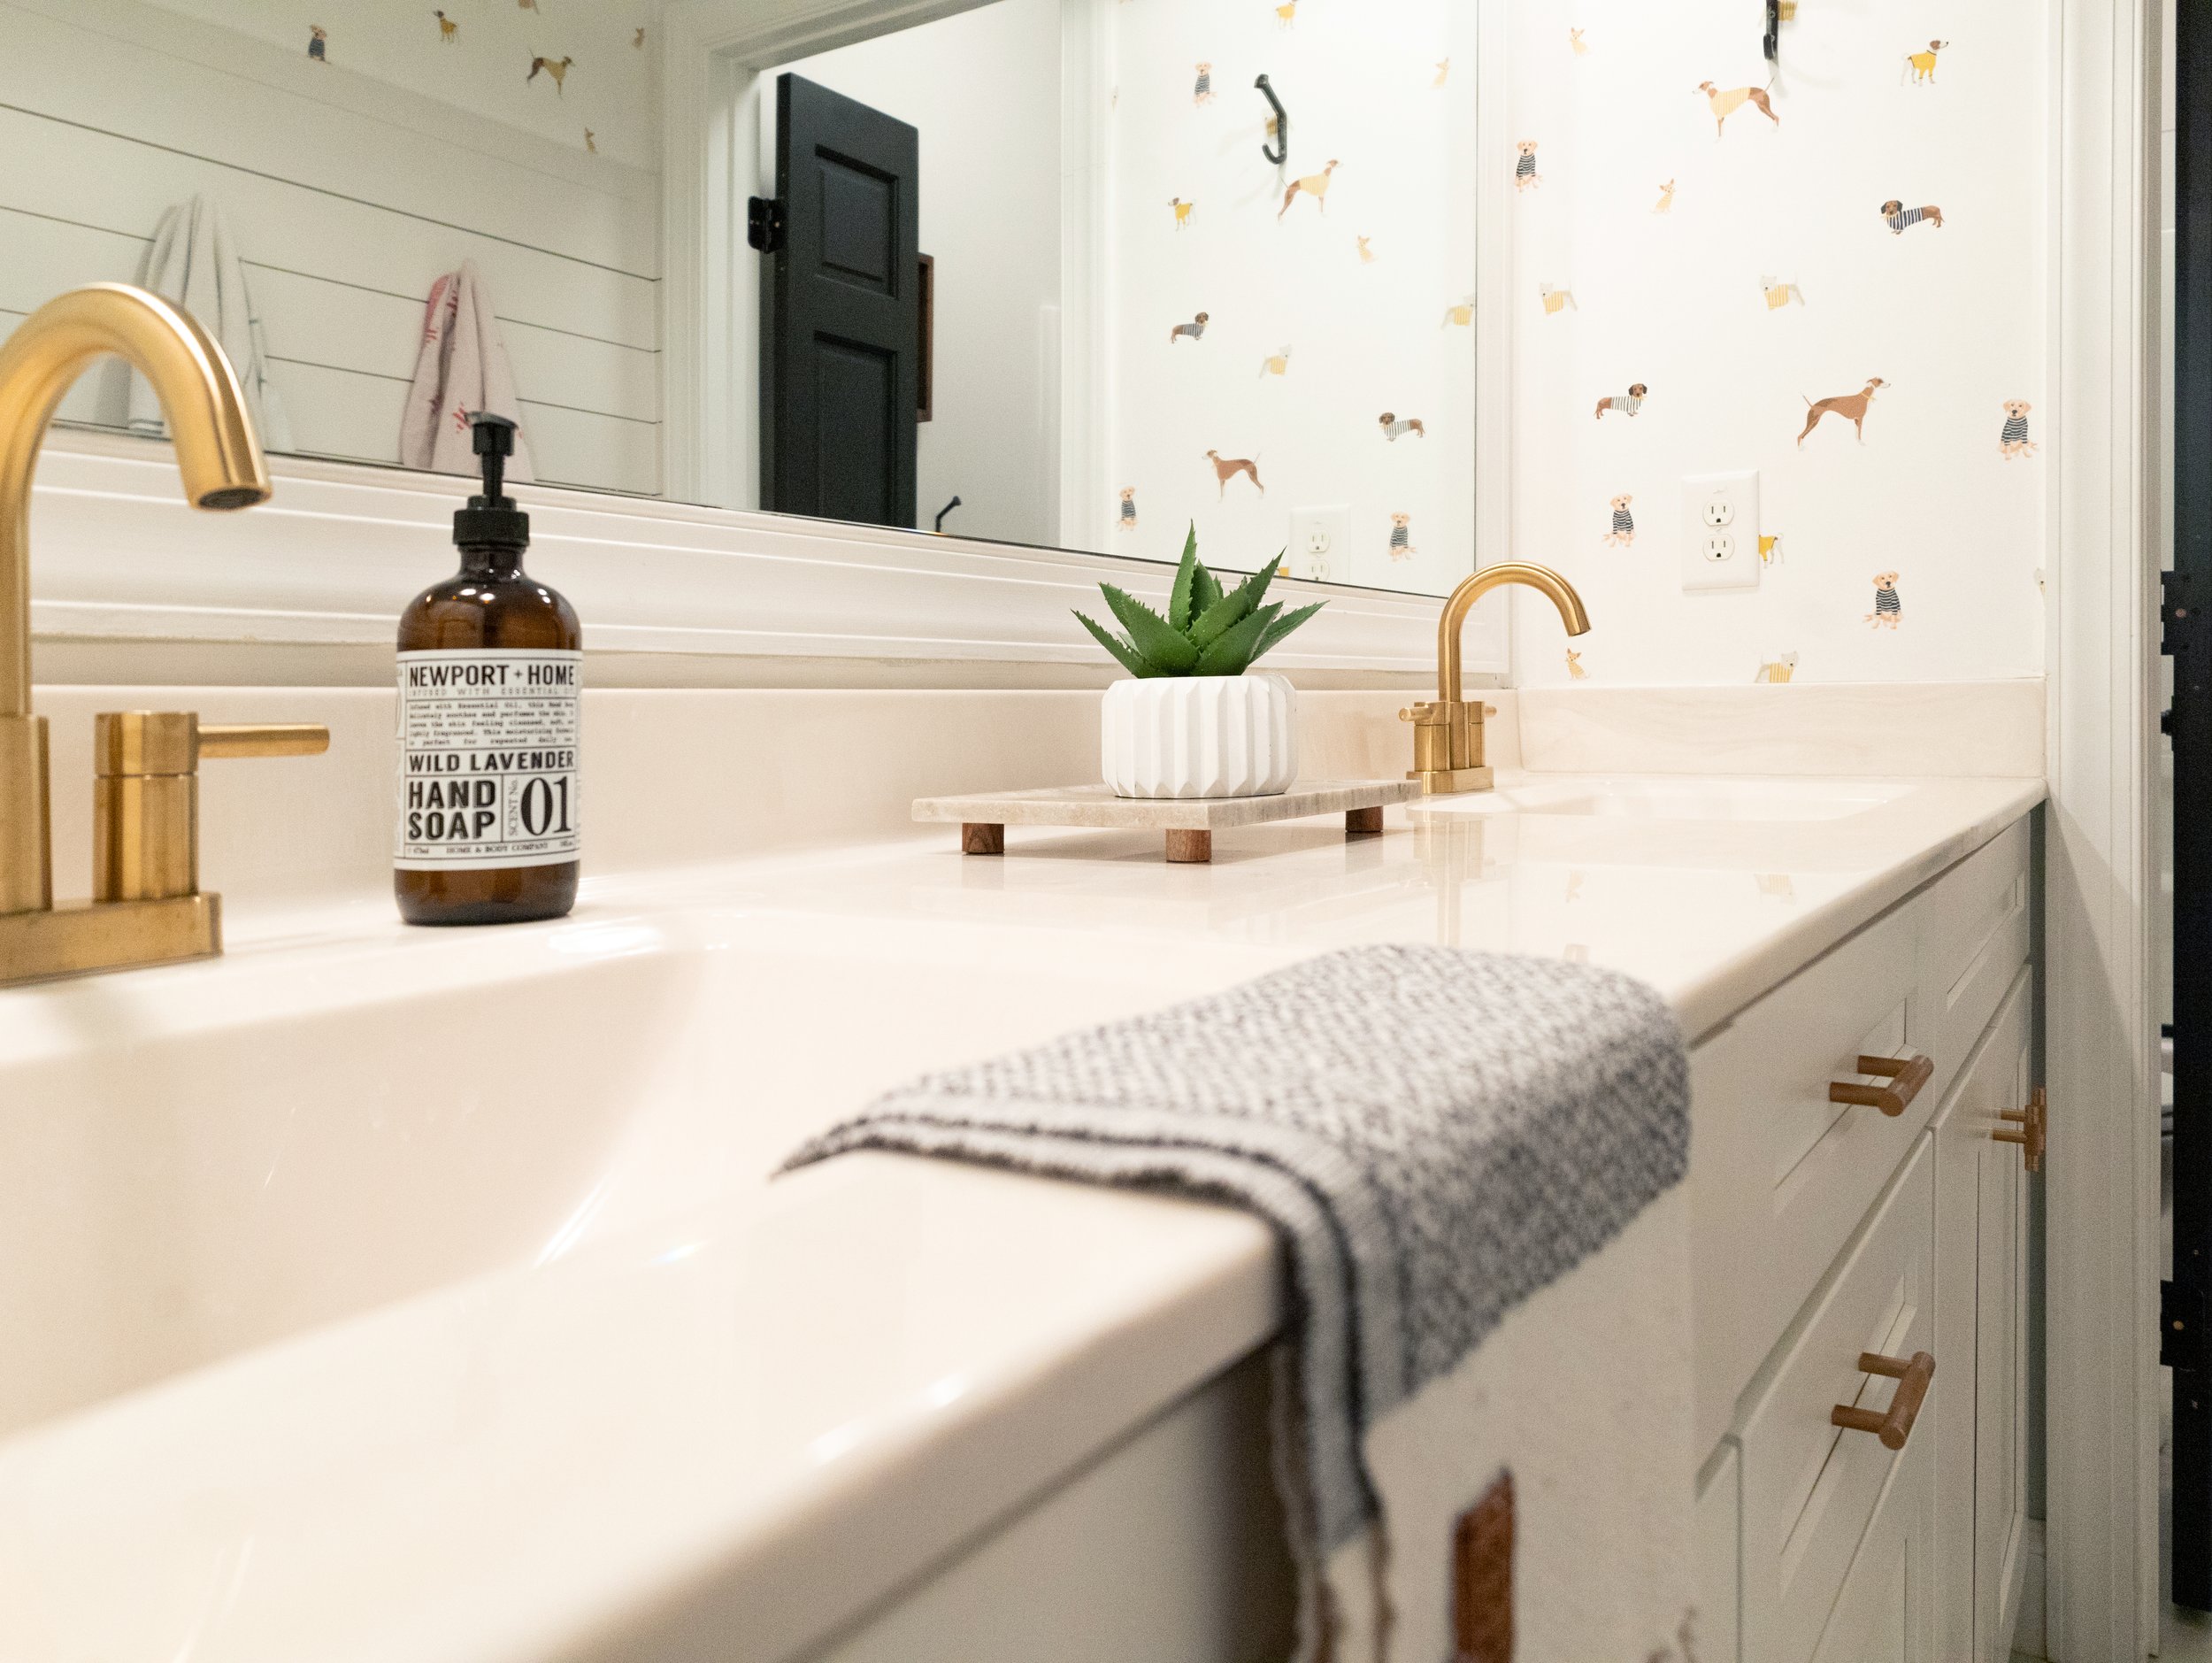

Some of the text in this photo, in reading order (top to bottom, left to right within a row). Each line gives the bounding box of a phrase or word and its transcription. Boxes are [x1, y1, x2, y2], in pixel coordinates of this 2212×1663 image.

[410, 665, 510, 687] NEWPORT
[527, 665, 574, 686] HOME
[410, 751, 573, 772] WILD LAVENDER
[409, 781, 496, 809] HAND
[520, 776, 572, 836] 01
[409, 811, 496, 840] SOAP
